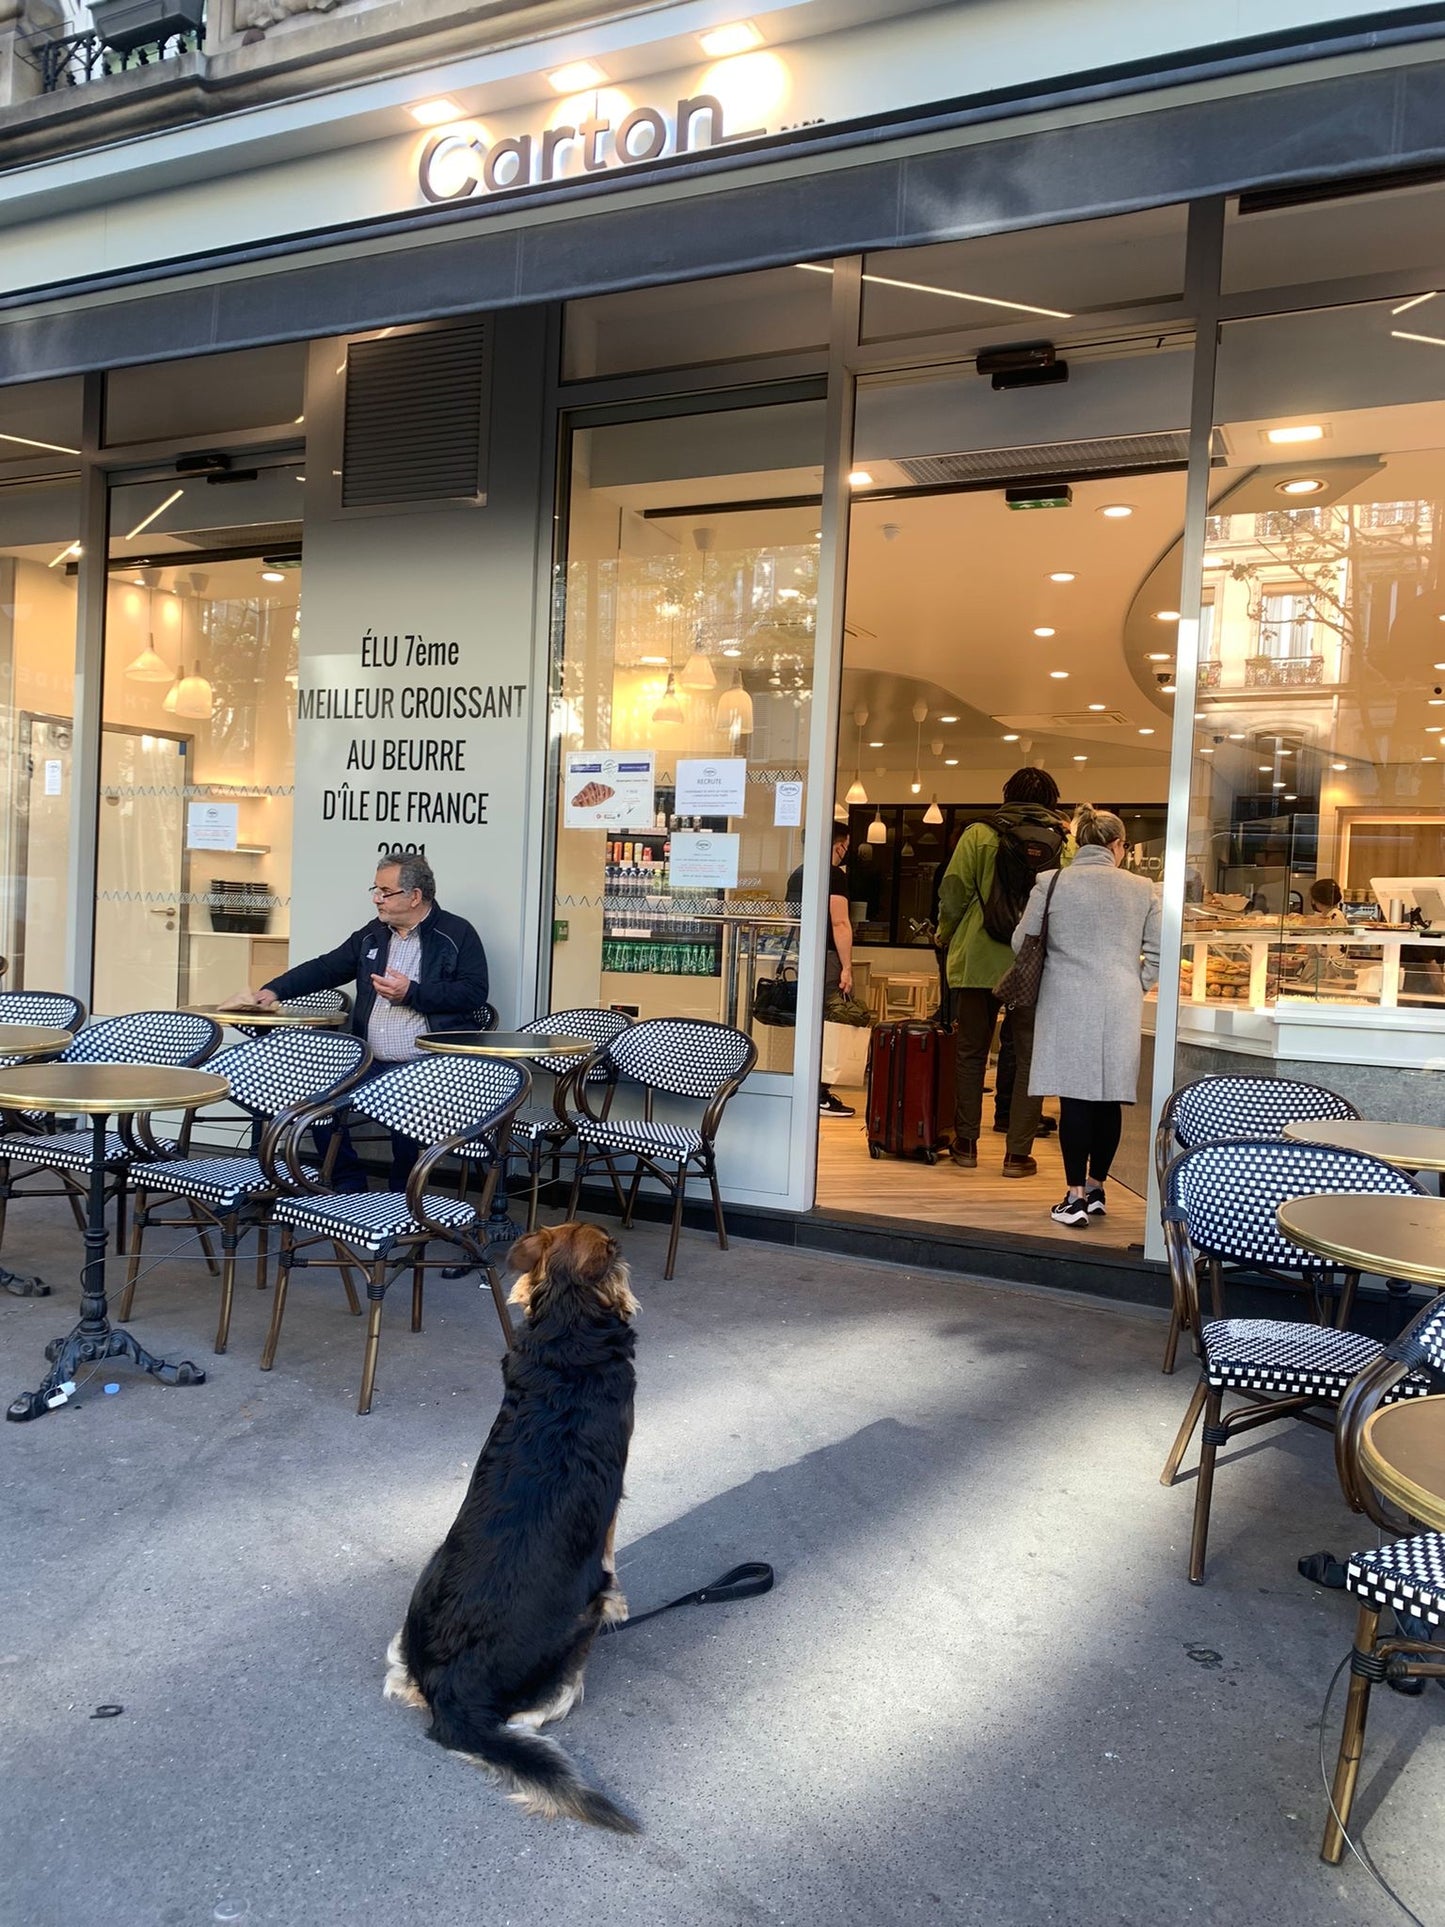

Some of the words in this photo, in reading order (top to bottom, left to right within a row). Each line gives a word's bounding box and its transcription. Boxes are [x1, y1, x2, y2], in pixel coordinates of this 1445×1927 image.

[419, 93, 766, 203] Carton
[361, 628, 398, 667] ÉLU
[405, 635, 459, 666] 7ème
[298, 687, 395, 719] MEILLEUR
[401, 685, 527, 719] CROISSANT
[346, 739, 376, 770] AU
[383, 739, 466, 771] BEURRE
[323, 782, 370, 821] D'ÎLE
[376, 791, 401, 822] DE
[407, 791, 489, 825] FRANCE
